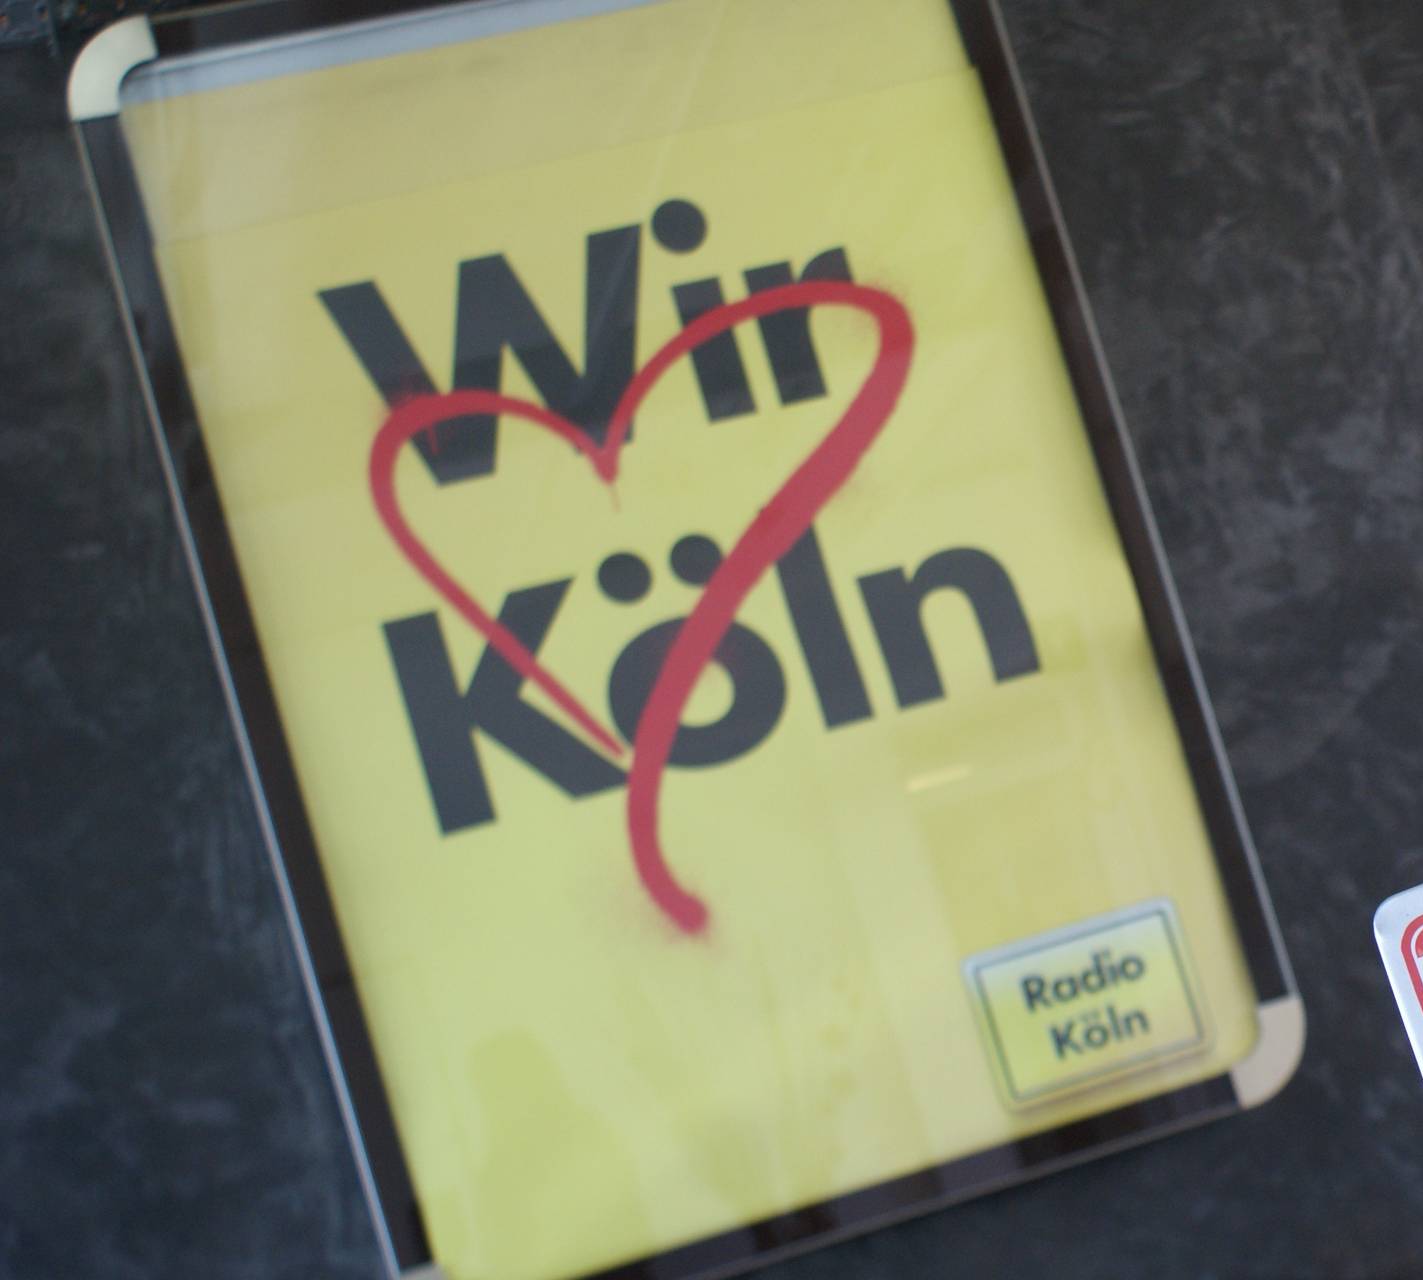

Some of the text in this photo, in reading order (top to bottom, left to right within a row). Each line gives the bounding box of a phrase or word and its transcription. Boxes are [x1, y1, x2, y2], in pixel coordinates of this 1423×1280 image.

[317, 199, 857, 488] Wir
[382, 508, 1043, 838] Köln
[1019, 947, 1147, 1014] Radio
[1048, 1003, 1150, 1060] Köln
